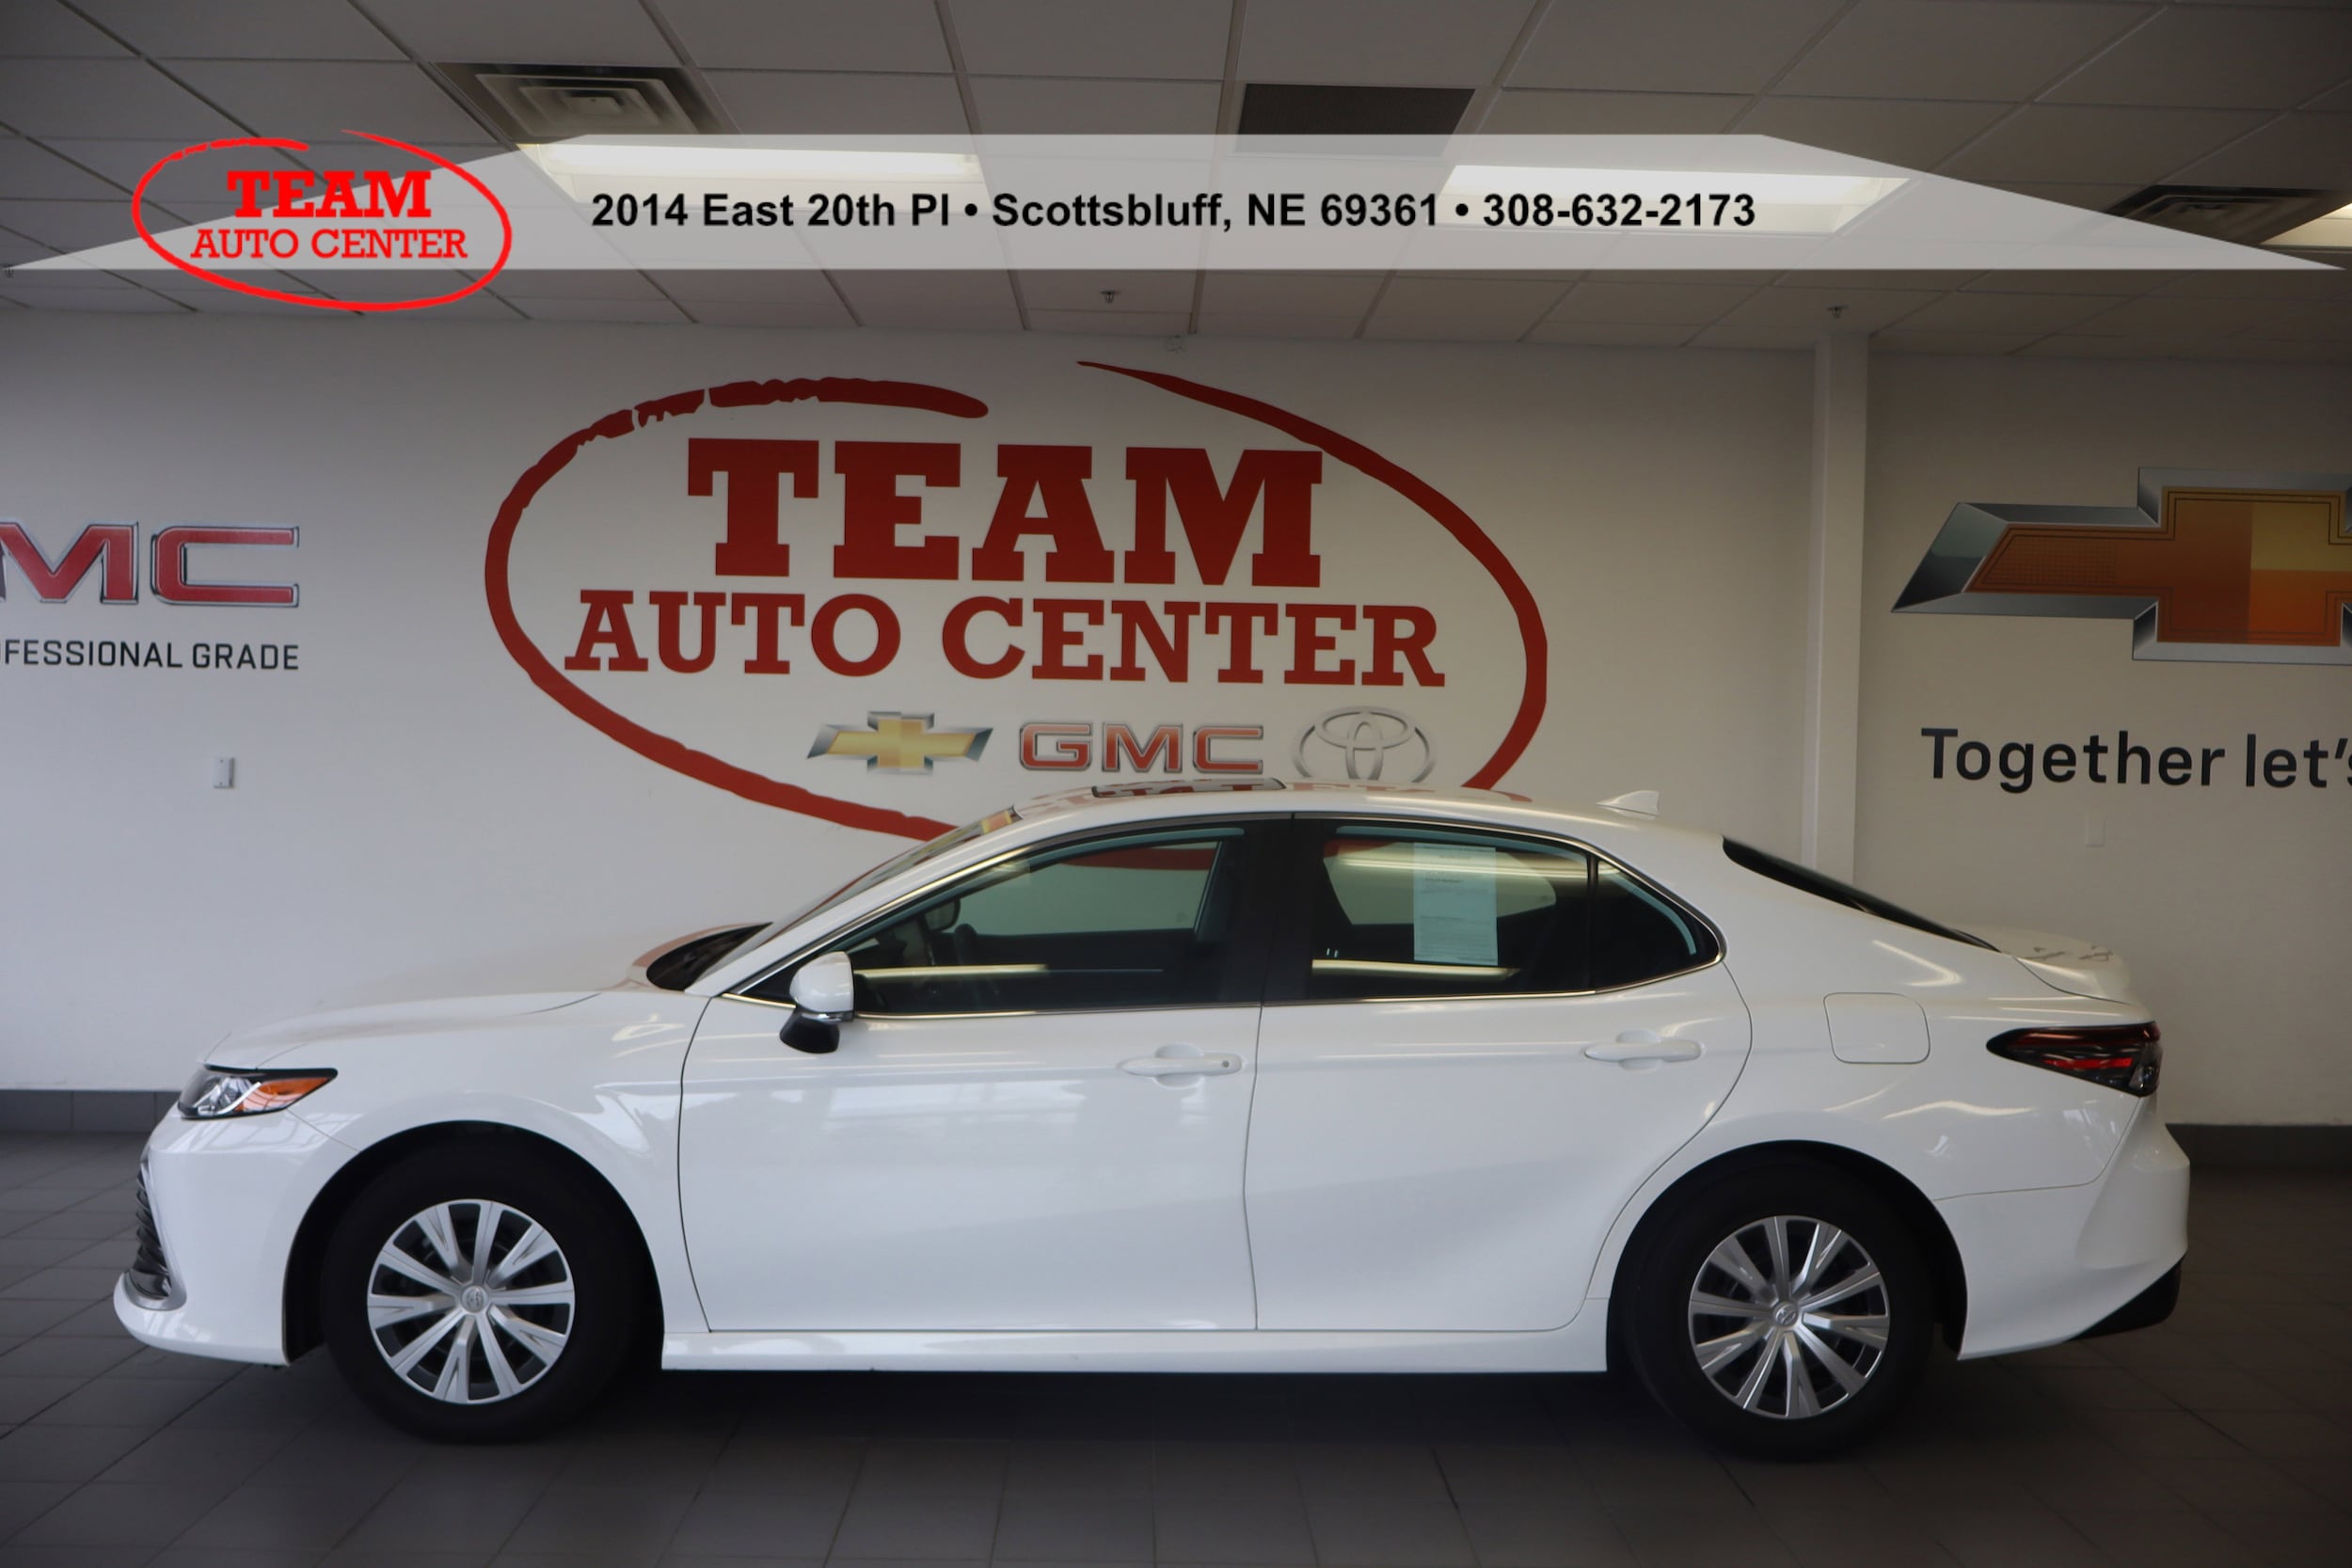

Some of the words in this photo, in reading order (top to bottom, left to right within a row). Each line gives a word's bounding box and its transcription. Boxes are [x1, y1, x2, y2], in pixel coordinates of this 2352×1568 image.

[688, 437, 1323, 588] TEAM
[0, 639, 183, 669] FESSIONAL
[192, 642, 299, 671] GRADE
[564, 589, 901, 677] AUTO
[942, 596, 1446, 688] CENTER
[1019, 721, 1264, 775] GMC
[1920, 727, 2226, 794] Together
